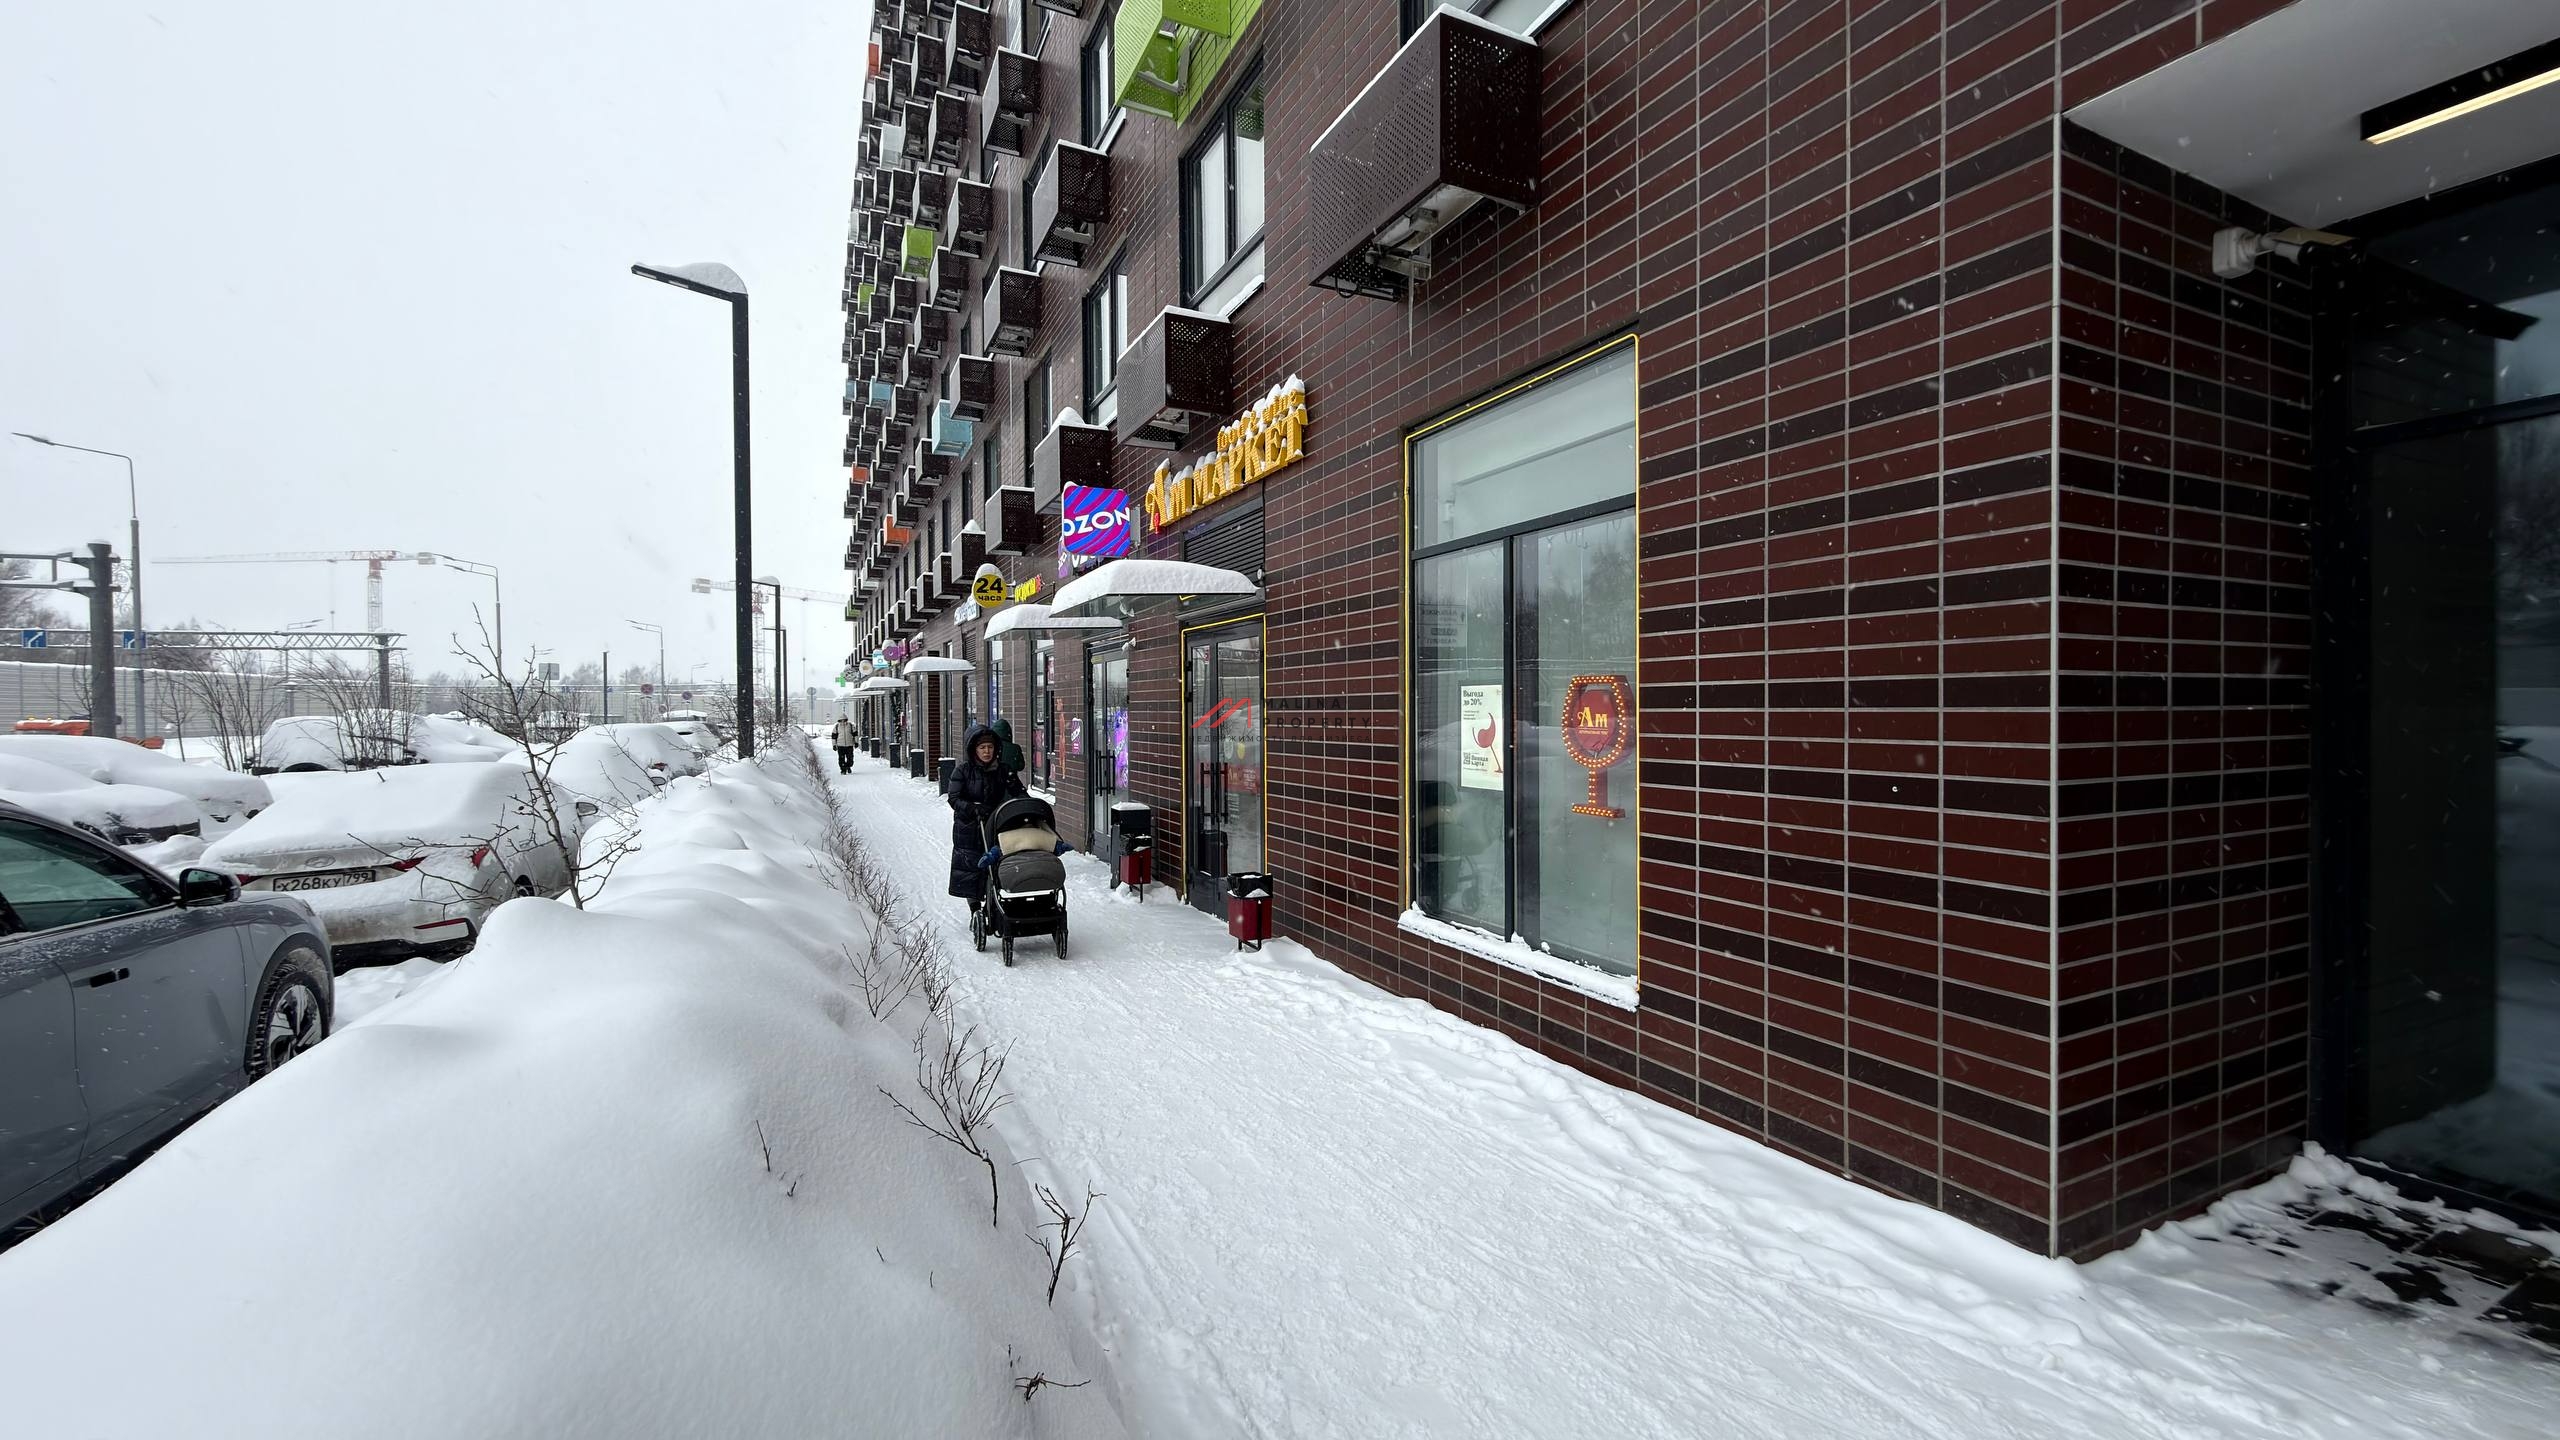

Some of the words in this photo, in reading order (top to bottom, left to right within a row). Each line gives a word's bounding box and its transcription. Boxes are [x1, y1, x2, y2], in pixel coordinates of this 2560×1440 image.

[1193, 406, 1308, 509] МАРКЕТ
[1063, 506, 1130, 537] OZON
[976, 577, 1003, 594] 24
[1463, 690, 1484, 698] Выгода
[1471, 698, 1482, 706] 20%
[344, 872, 369, 884] 799
